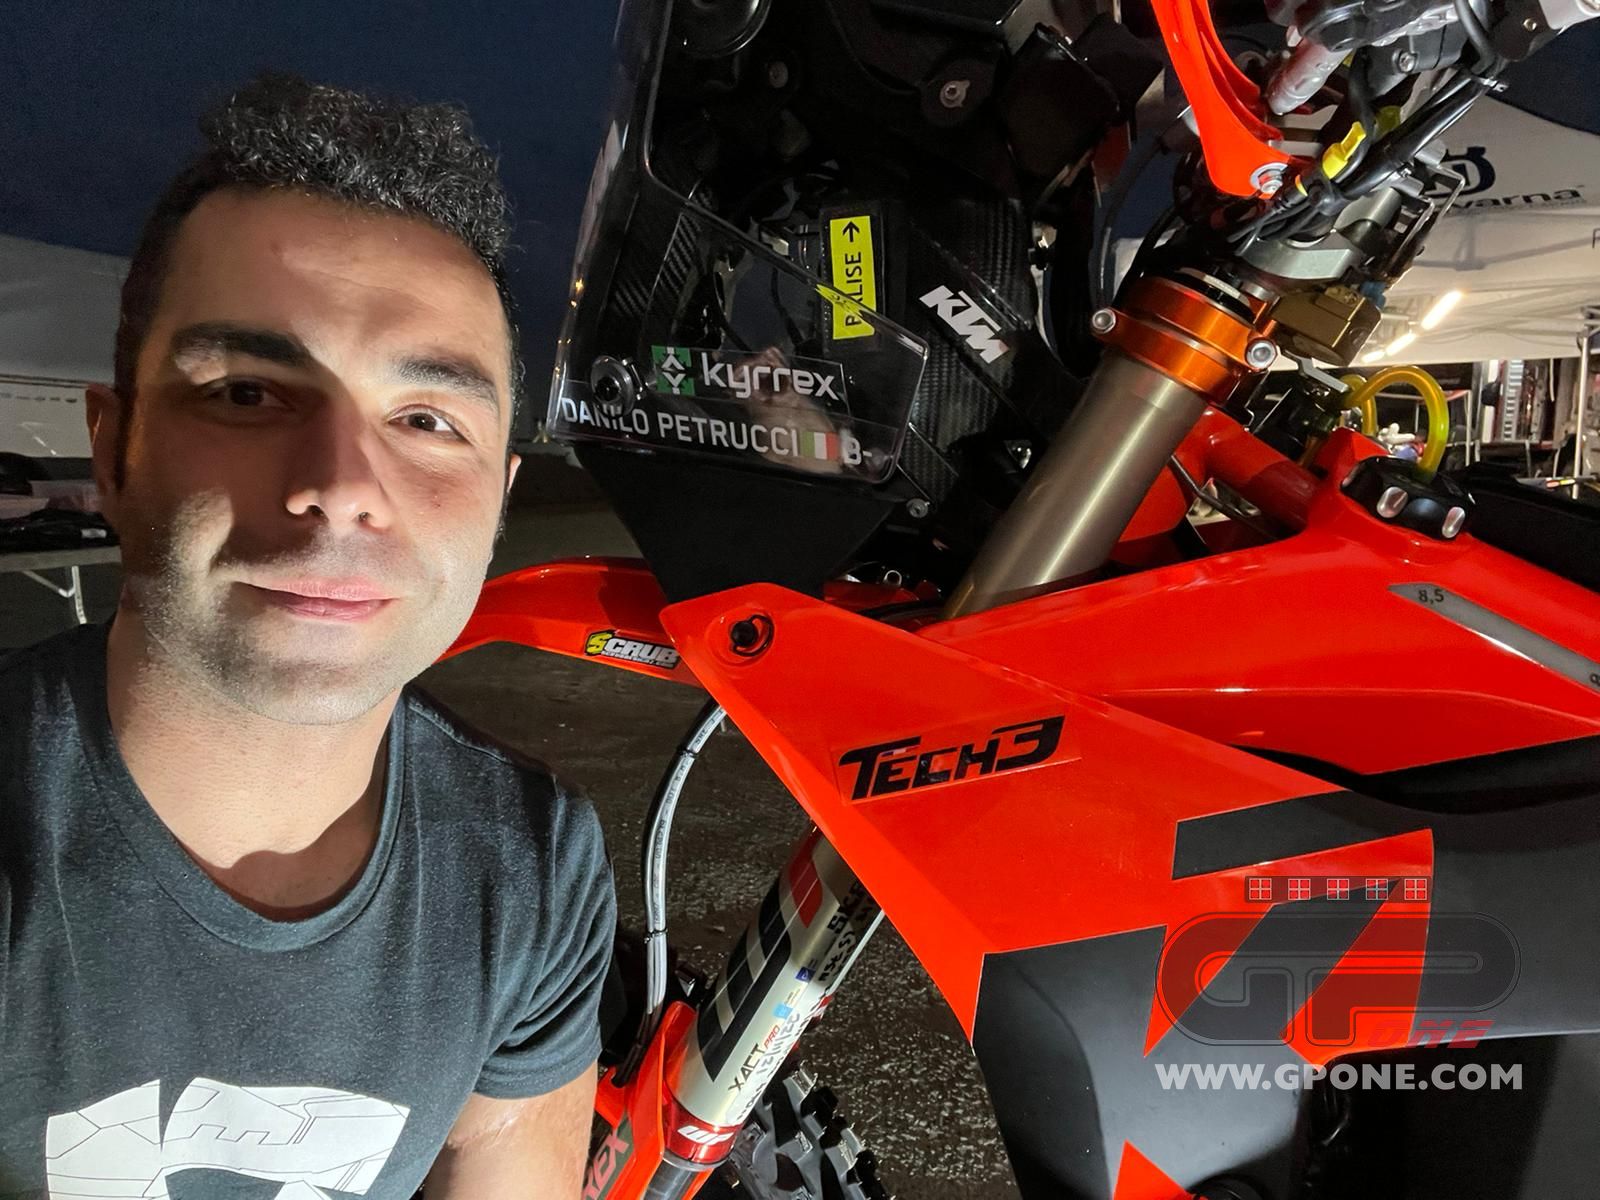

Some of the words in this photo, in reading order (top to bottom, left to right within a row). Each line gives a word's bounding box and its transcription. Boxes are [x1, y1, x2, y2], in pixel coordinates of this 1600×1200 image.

[1446, 189, 1582, 208] varna
[844, 252, 862, 327] PLISE
[919, 285, 1010, 364] KTM
[701, 352, 839, 400] kyrrex
[657, 412, 799, 457] PETRUCCI
[1418, 588, 1445, 604] 8,5
[586, 632, 678, 664] SCRUB
[839, 715, 1065, 800] TECH3
[727, 1042, 767, 1095] XACT
[763, 1024, 781, 1048] PRO
